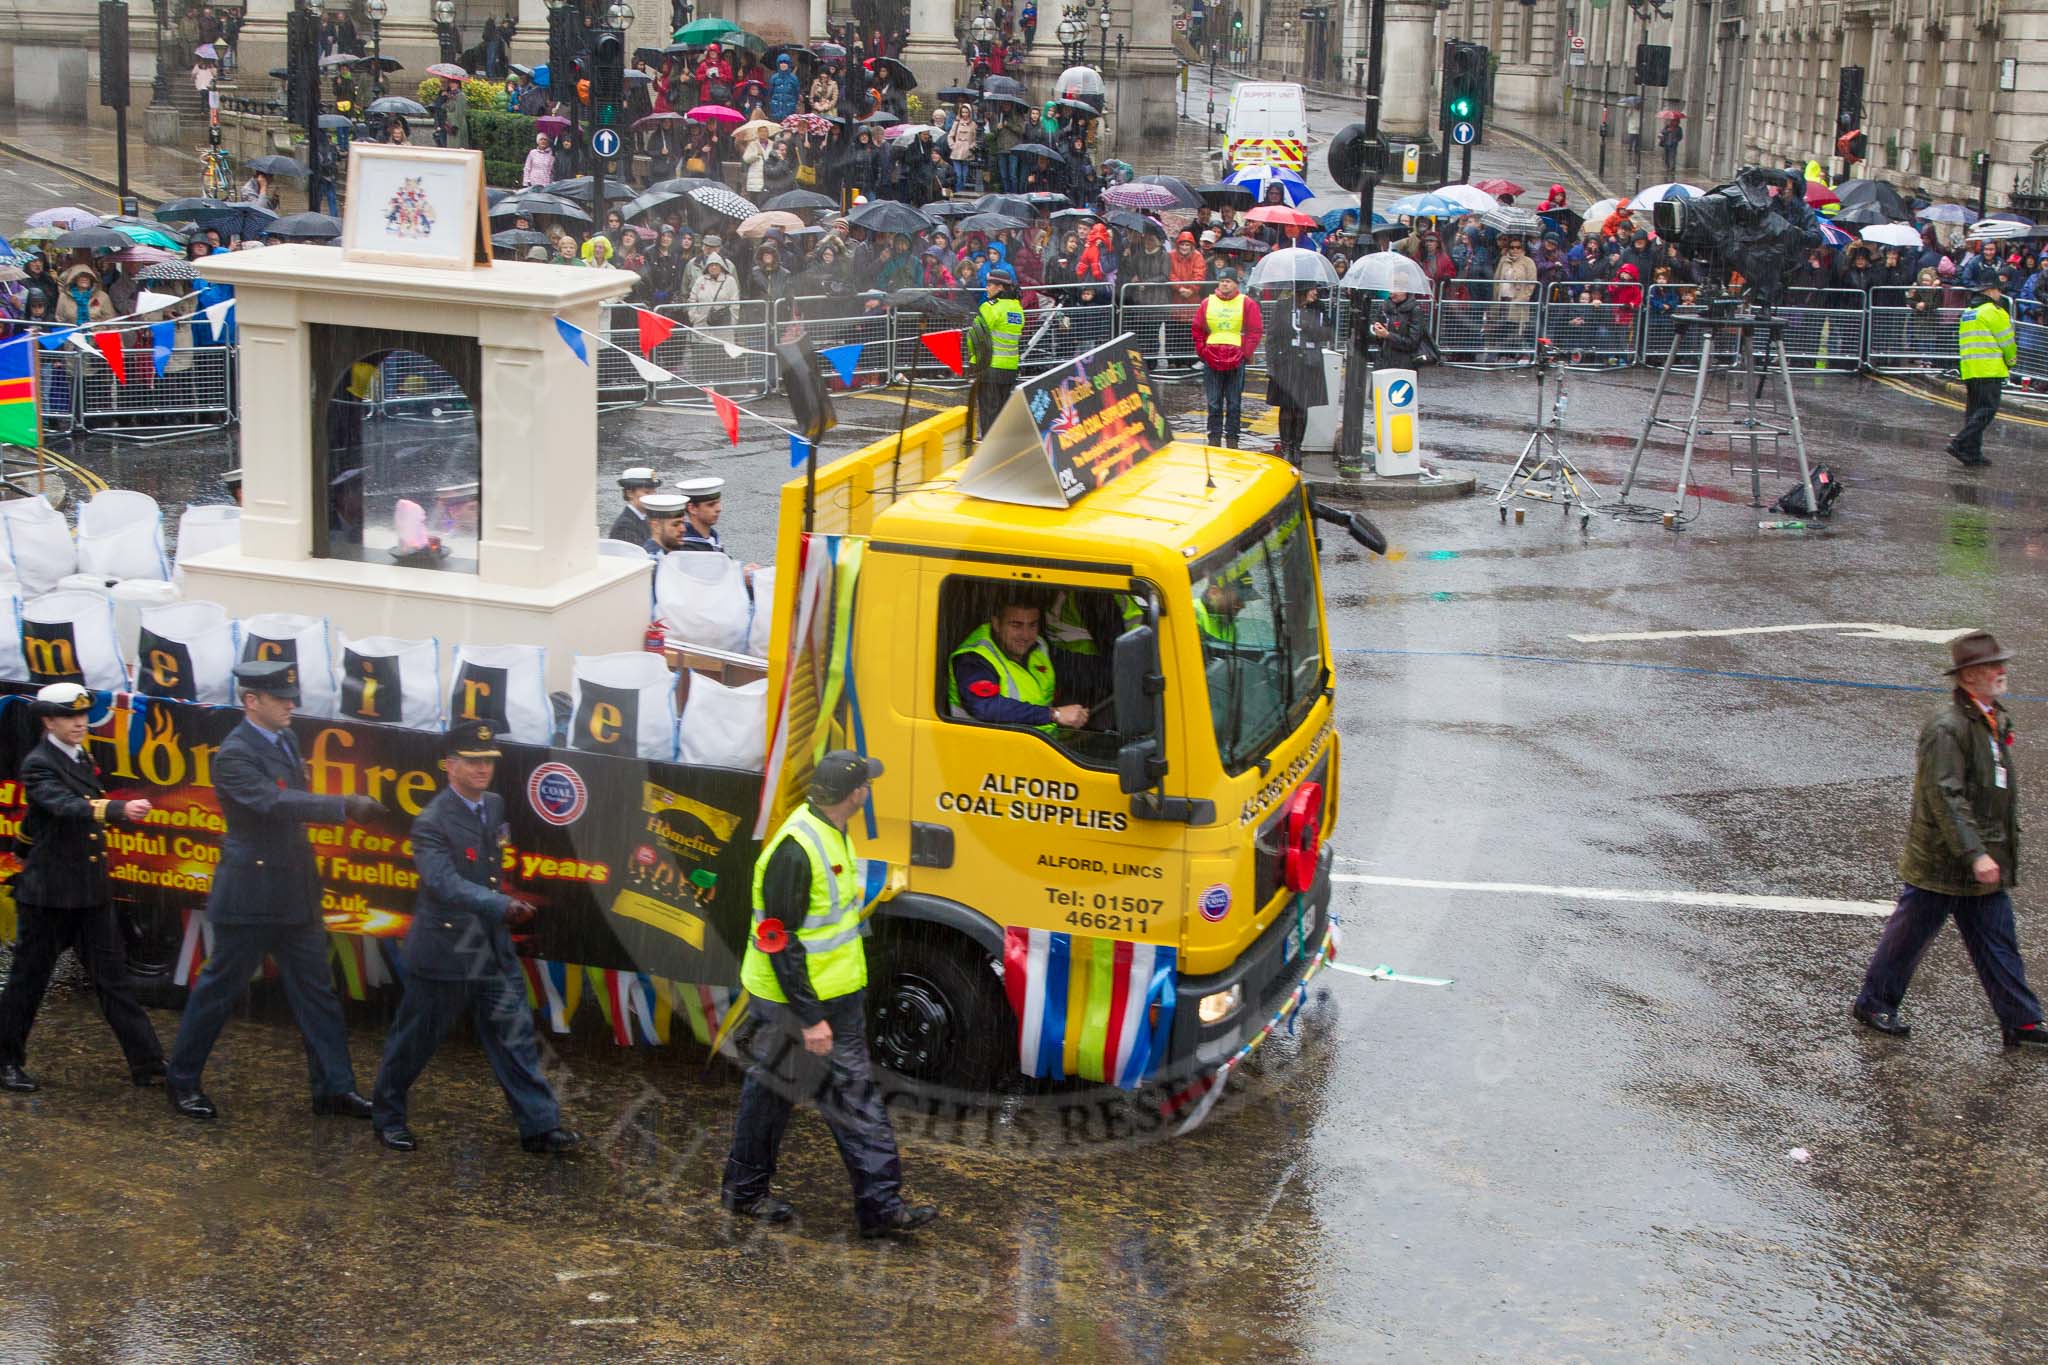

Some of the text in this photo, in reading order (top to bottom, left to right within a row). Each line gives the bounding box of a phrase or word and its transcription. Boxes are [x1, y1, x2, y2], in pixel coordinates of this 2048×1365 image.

[149, 648, 180, 688] e
[588, 701, 624, 744] e
[981, 773, 1079, 801] ALFORD
[937, 792, 1128, 832] COAL SUPPLIES
[350, 828, 396, 852] for
[521, 855, 608, 881] years
[646, 816, 721, 857] Homefire
[331, 857, 420, 889] Fueller
[1036, 854, 1163, 879] ALFORD, LINCS
[1045, 887, 1163, 915] Tel: 01507
[1065, 911, 1148, 933] 466211
